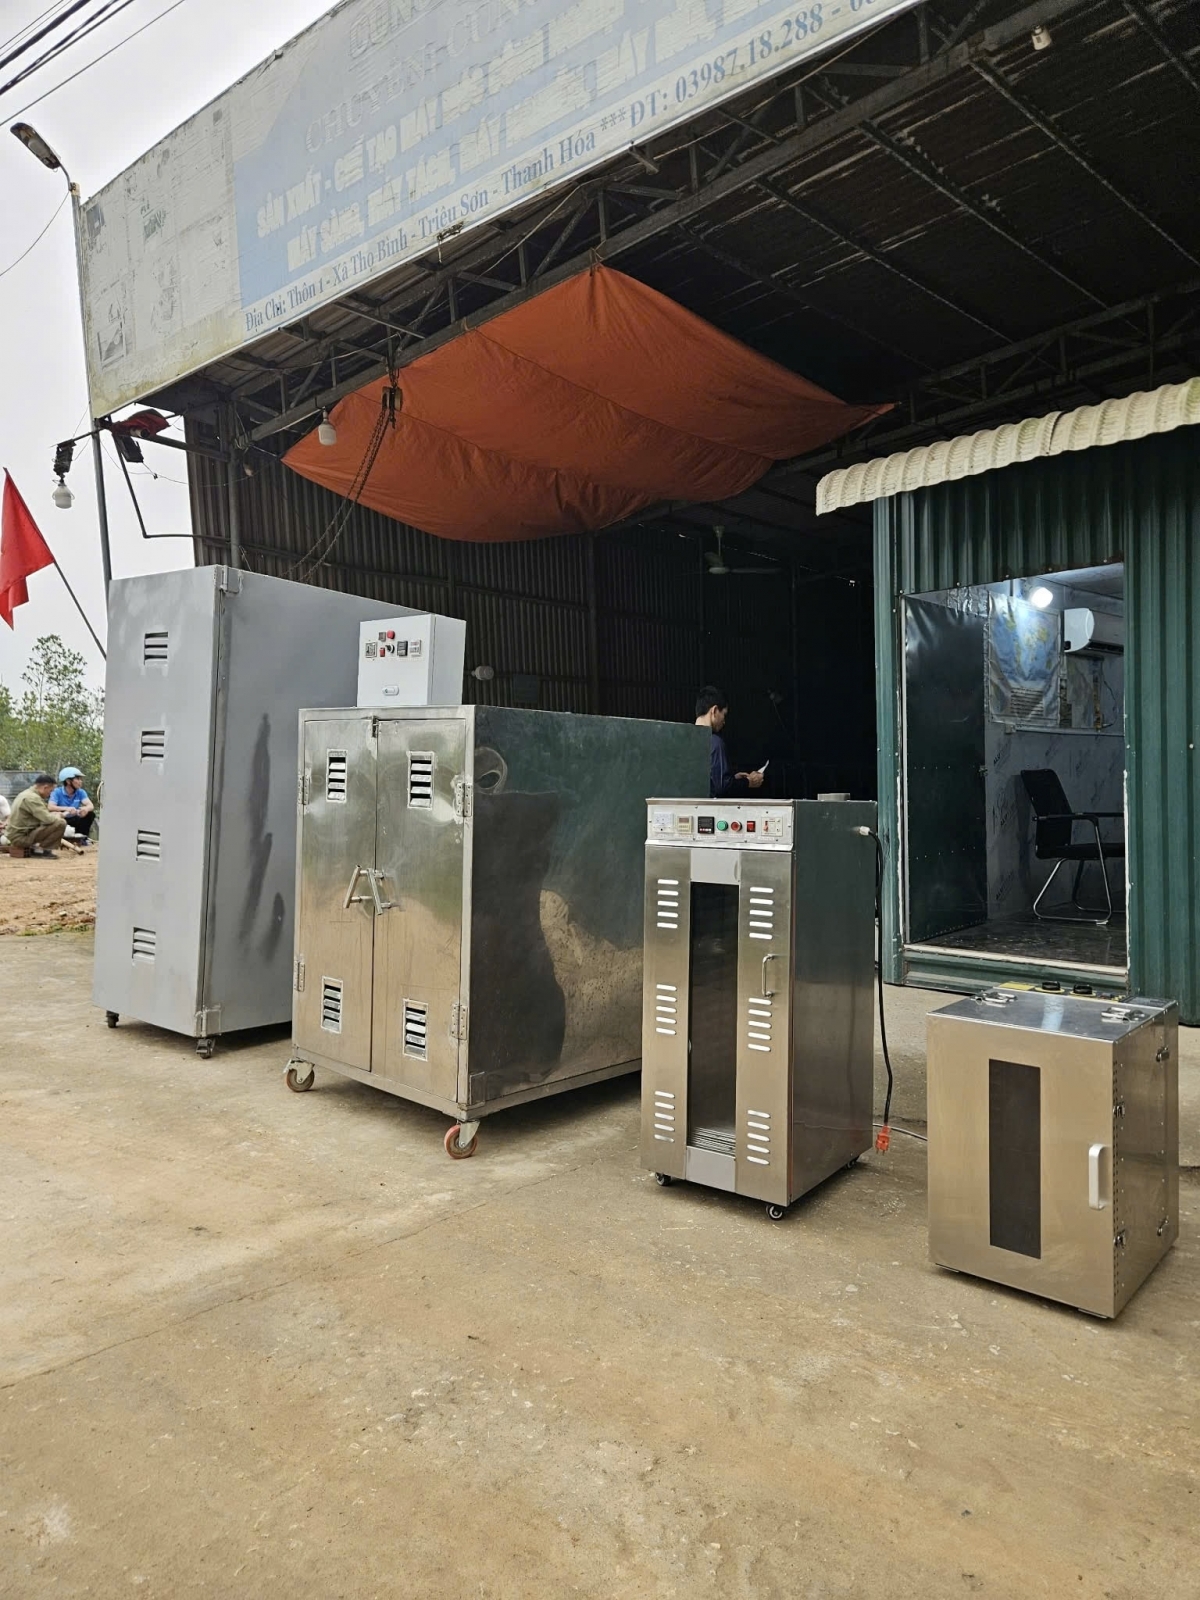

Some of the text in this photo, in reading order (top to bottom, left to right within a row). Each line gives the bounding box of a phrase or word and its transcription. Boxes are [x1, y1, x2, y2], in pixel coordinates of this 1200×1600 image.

[245, 308, 264, 333] Địa
[287, 282, 316, 309] Thôn
[377, 228, 408, 262] Bình
[460, 189, 489, 217] Sơn
[501, 148, 554, 195] Thanh
[559, 129, 596, 165] Hóa
[675, 3, 824, 103] 03987.18.288
